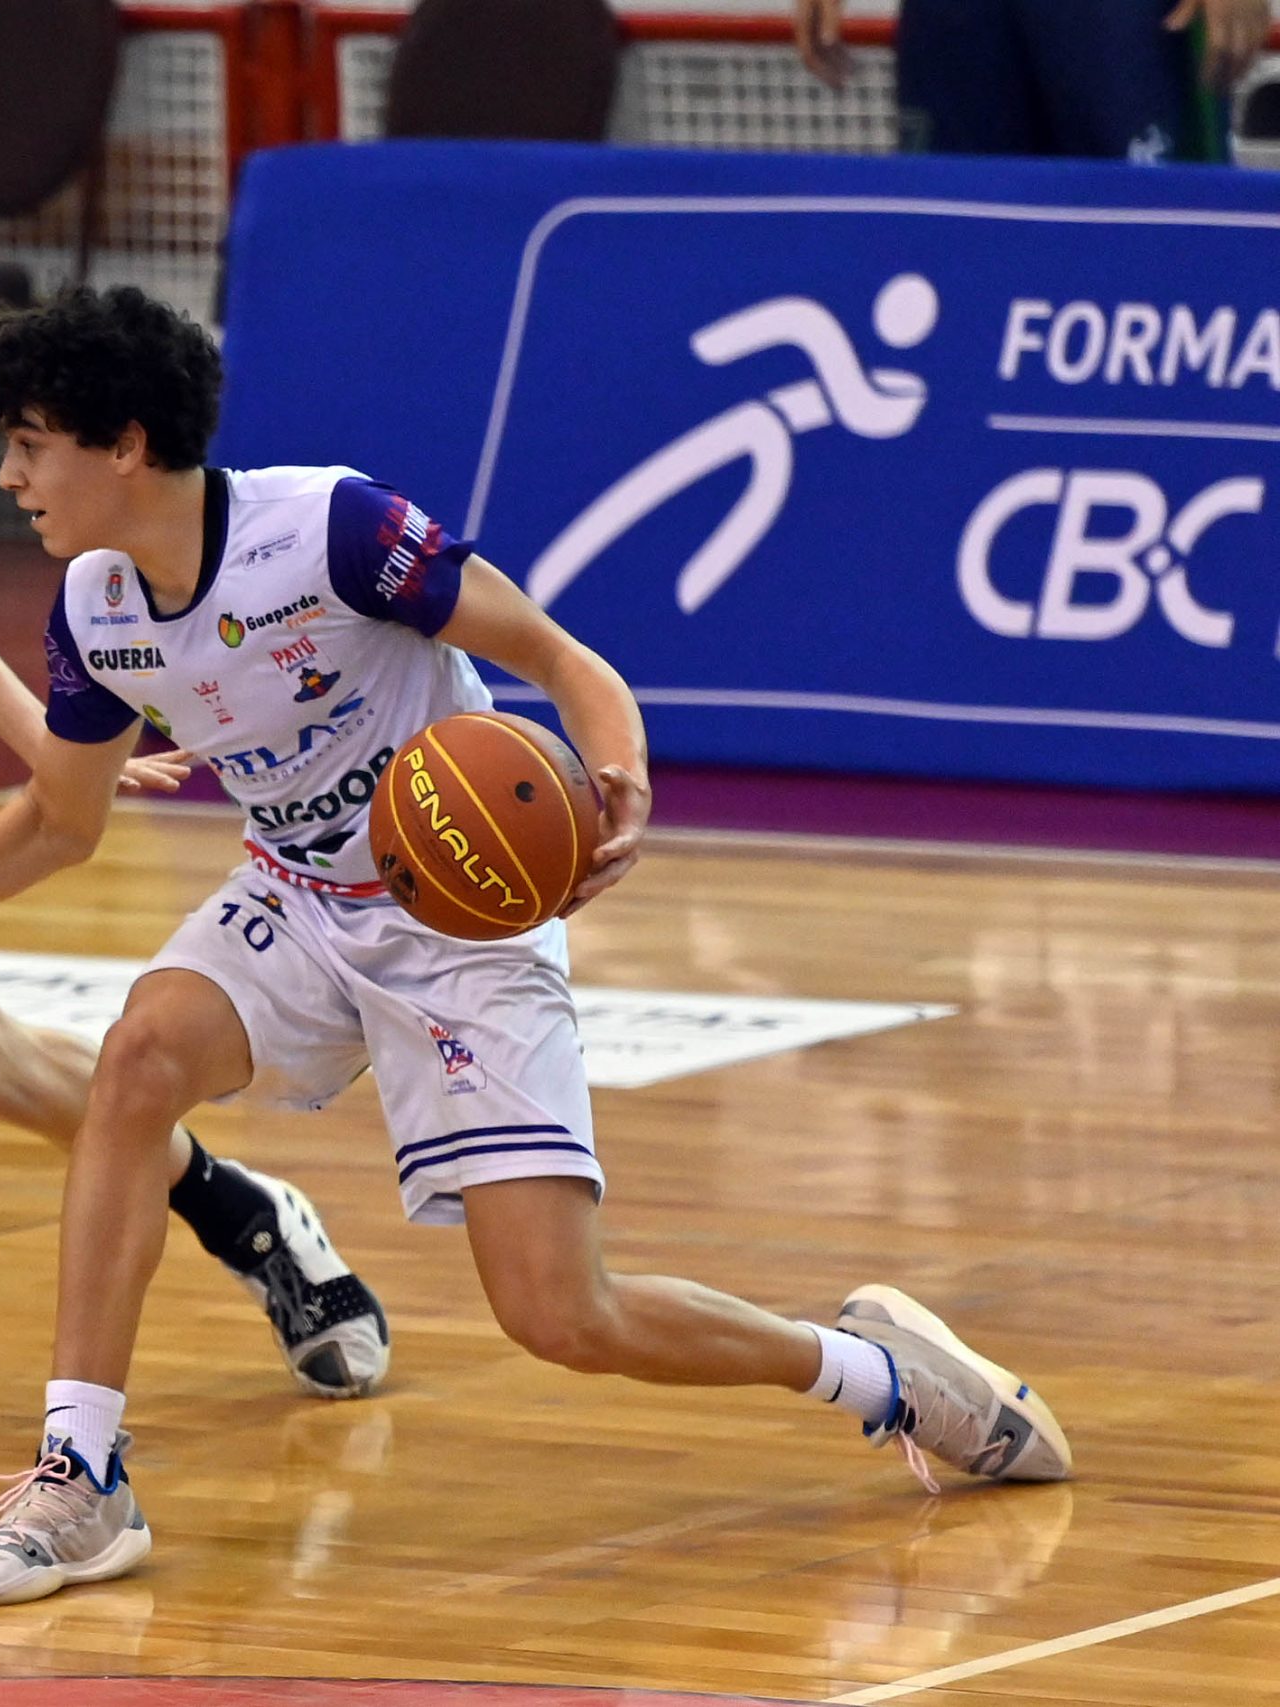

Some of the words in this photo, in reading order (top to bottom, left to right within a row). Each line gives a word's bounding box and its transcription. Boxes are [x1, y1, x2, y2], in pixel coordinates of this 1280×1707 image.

[997, 297, 1280, 392] FORMA
[957, 466, 1266, 650] CBC
[246, 594, 320, 631] Guepardo
[88, 647, 166, 671] GUERRA
[270, 635, 318, 671] PATO
[403, 746, 525, 909] PENALTY
[218, 902, 275, 953] 10
